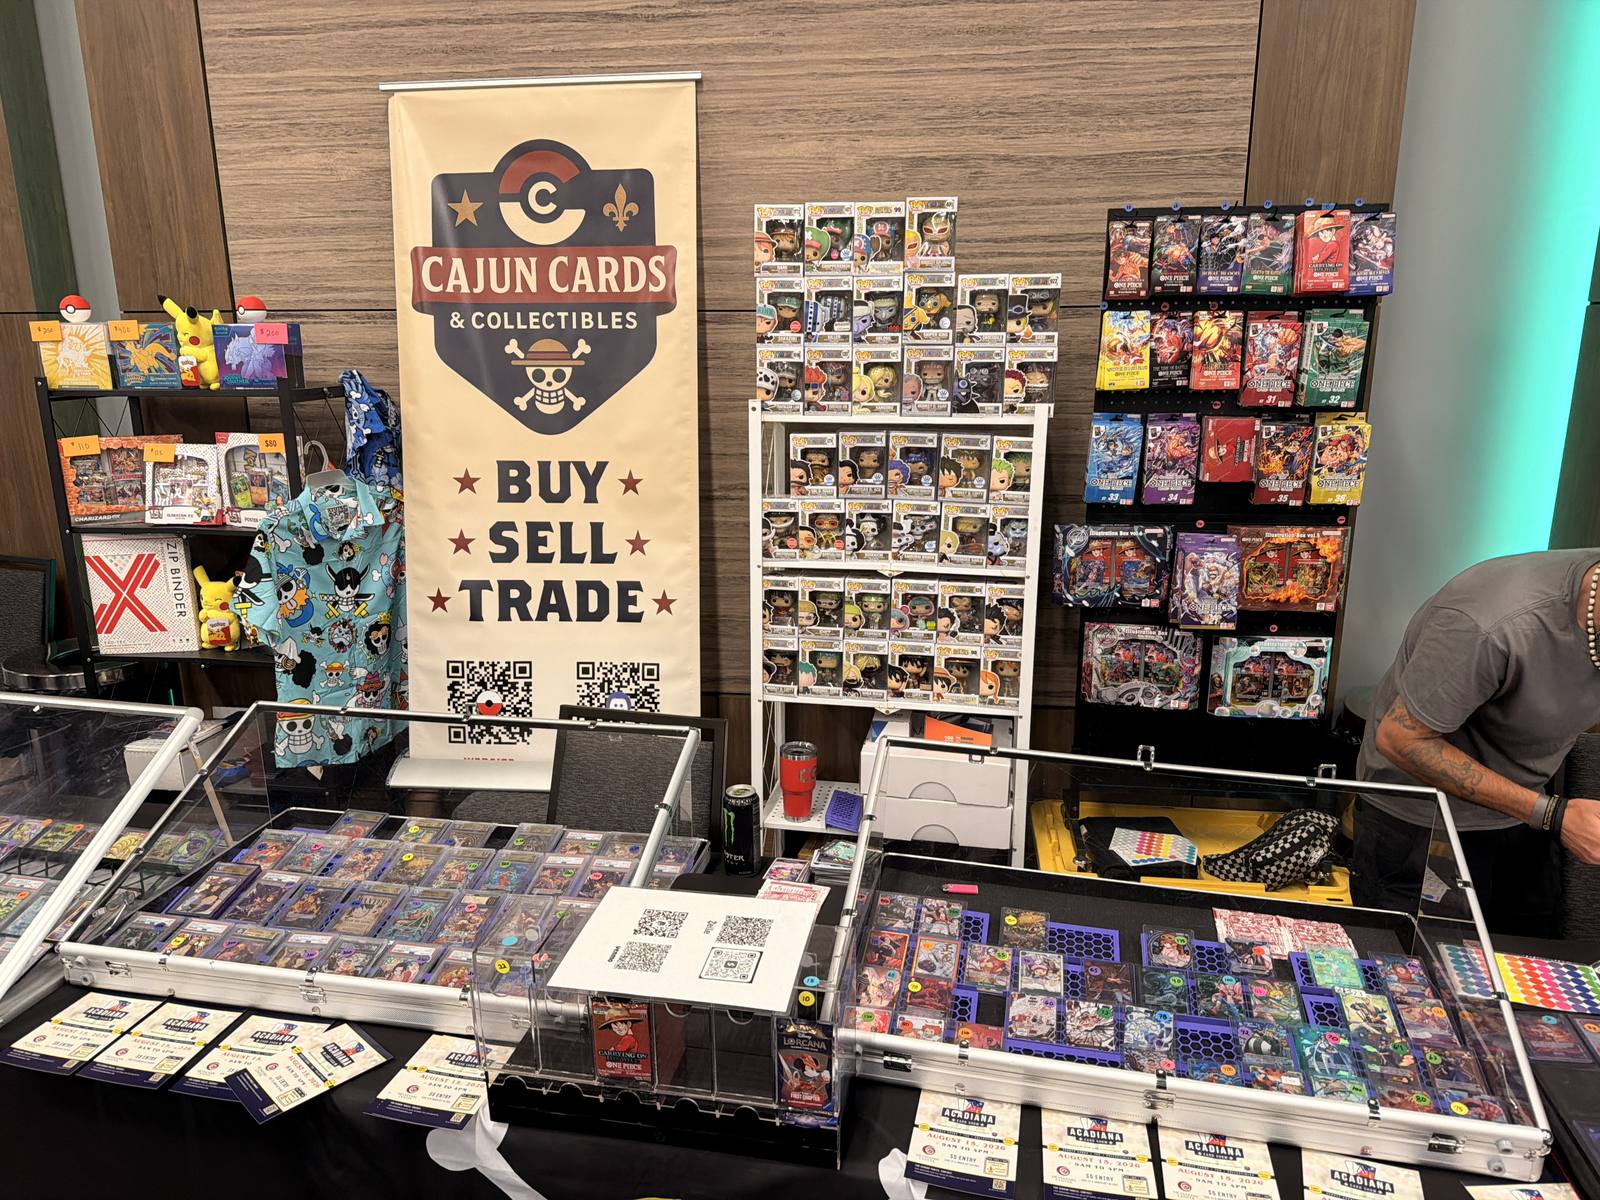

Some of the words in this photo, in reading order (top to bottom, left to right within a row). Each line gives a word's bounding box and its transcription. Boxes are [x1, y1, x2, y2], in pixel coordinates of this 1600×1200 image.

[421, 256, 537, 294] CAJUN
[548, 254, 667, 294] CARDS
[450, 313, 465, 329] &
[471, 311, 638, 330] COLLECTIBLES
[1266, 395, 1277, 403] 31
[1328, 395, 1340, 403] 32
[265, 439, 277, 448] $80
[496, 460, 610, 504] BUY
[1167, 493, 1179, 501] 34
[488, 521, 618, 564] SELL
[166, 543, 178, 563] ZIP
[171, 568, 187, 618] BINDER
[458, 579, 645, 623] TRADE
[254, 1031, 295, 1042] ACADIANA
[783, 1037, 827, 1049] LORCANA
[944, 1109, 993, 1123] ACADIANA
[927, 1132, 961, 1144] AUGUST
[1069, 1128, 1122, 1141] ACADIANA
[1187, 1142, 1242, 1157] ACADIANA
[1057, 1153, 1094, 1163] AUGUST
[1178, 1168, 1215, 1178] AUGUST
[1334, 1171, 1392, 1192] ACADIANA
